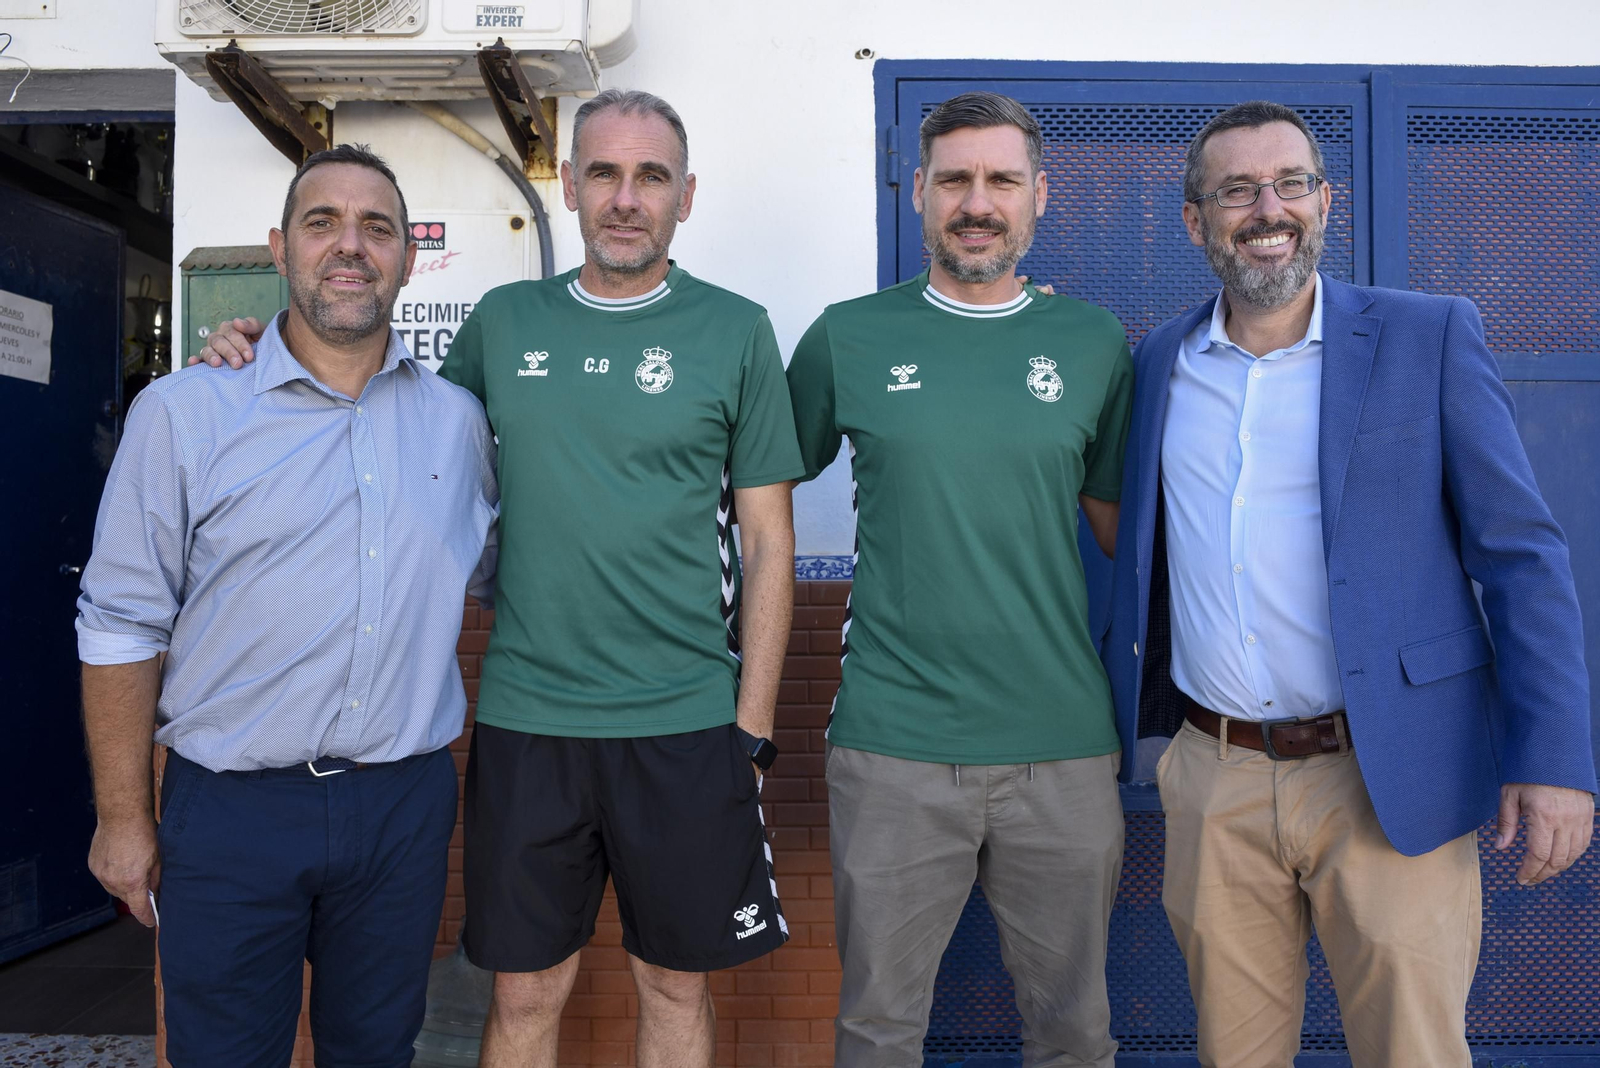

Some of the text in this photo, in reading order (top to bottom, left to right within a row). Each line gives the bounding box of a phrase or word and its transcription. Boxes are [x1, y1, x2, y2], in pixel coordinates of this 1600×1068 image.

[476, 15, 524, 27] EXPERT
[391, 303, 477, 322] LECIMIE
[8, 353, 26, 364] 21:00
[518, 368, 548, 376] hummel
[584, 358, 610, 374] C.G
[887, 380, 921, 392] hummel
[736, 920, 767, 940] hummel
